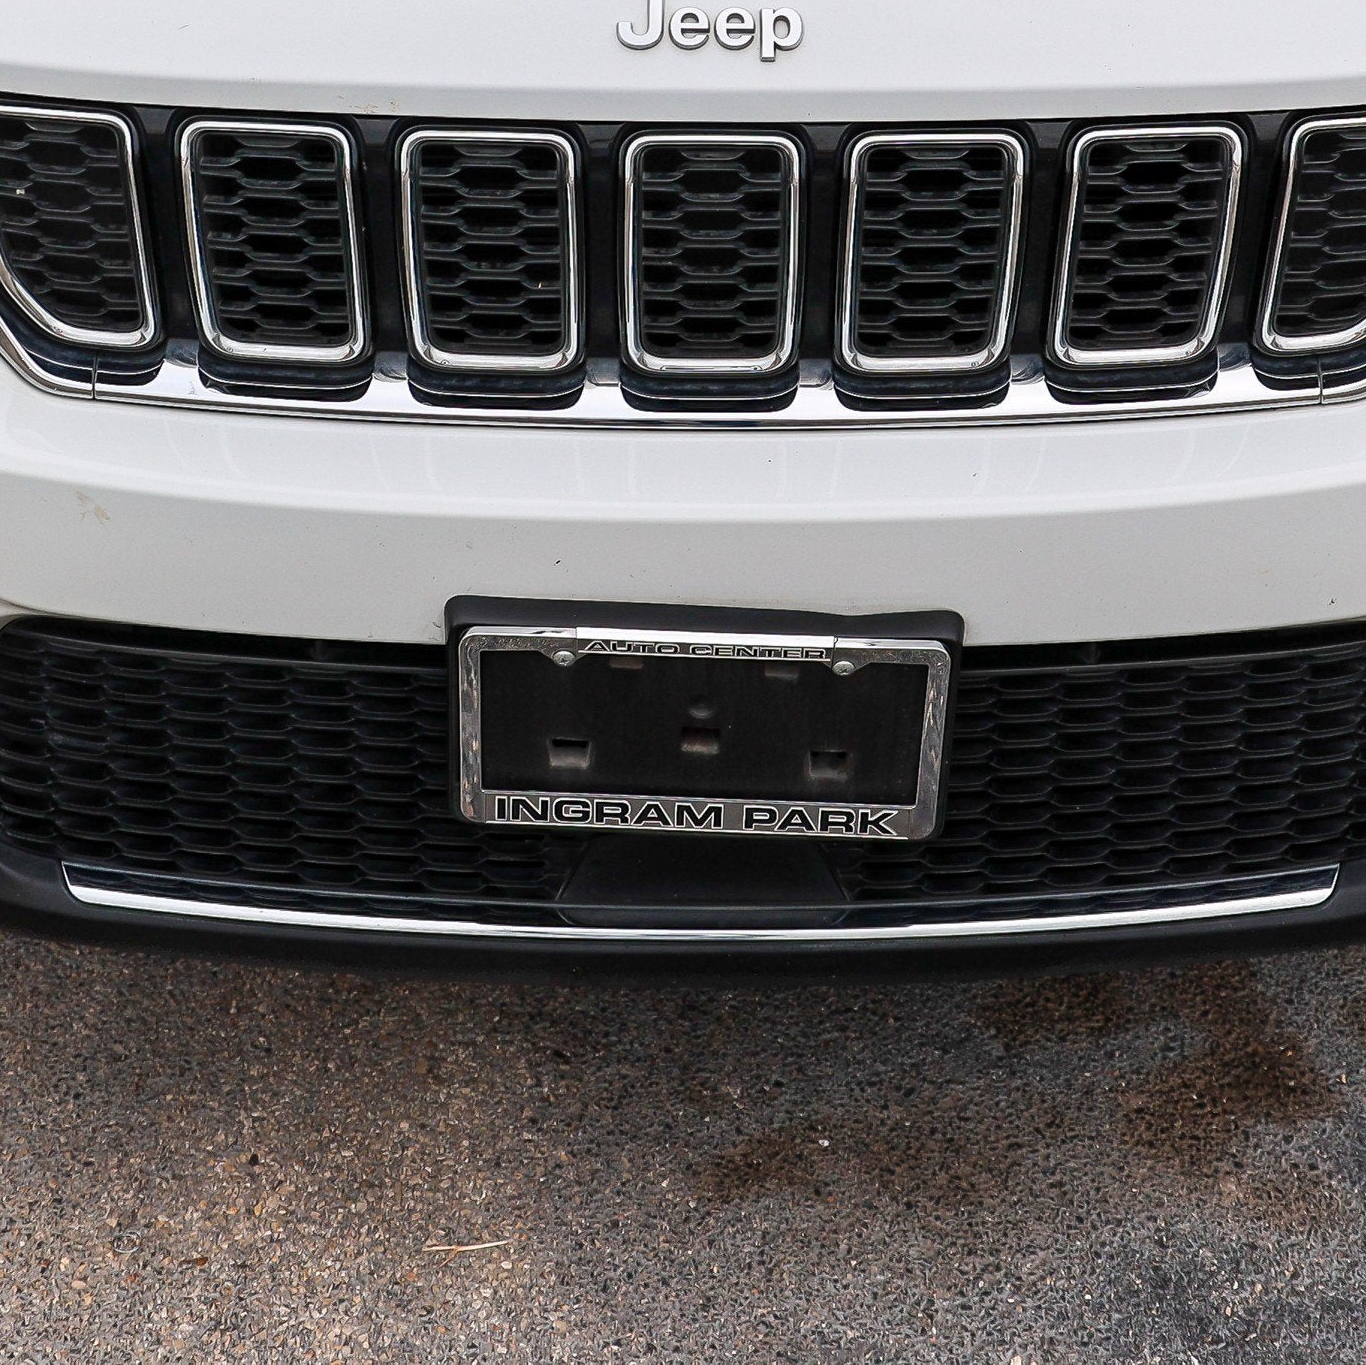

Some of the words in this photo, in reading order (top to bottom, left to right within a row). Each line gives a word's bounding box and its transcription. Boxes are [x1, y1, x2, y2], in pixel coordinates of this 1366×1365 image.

[584, 640, 680, 654] AUTO
[689, 643, 827, 660] CENTER
[494, 795, 724, 830] INGRAM
[743, 804, 900, 836] PARK
